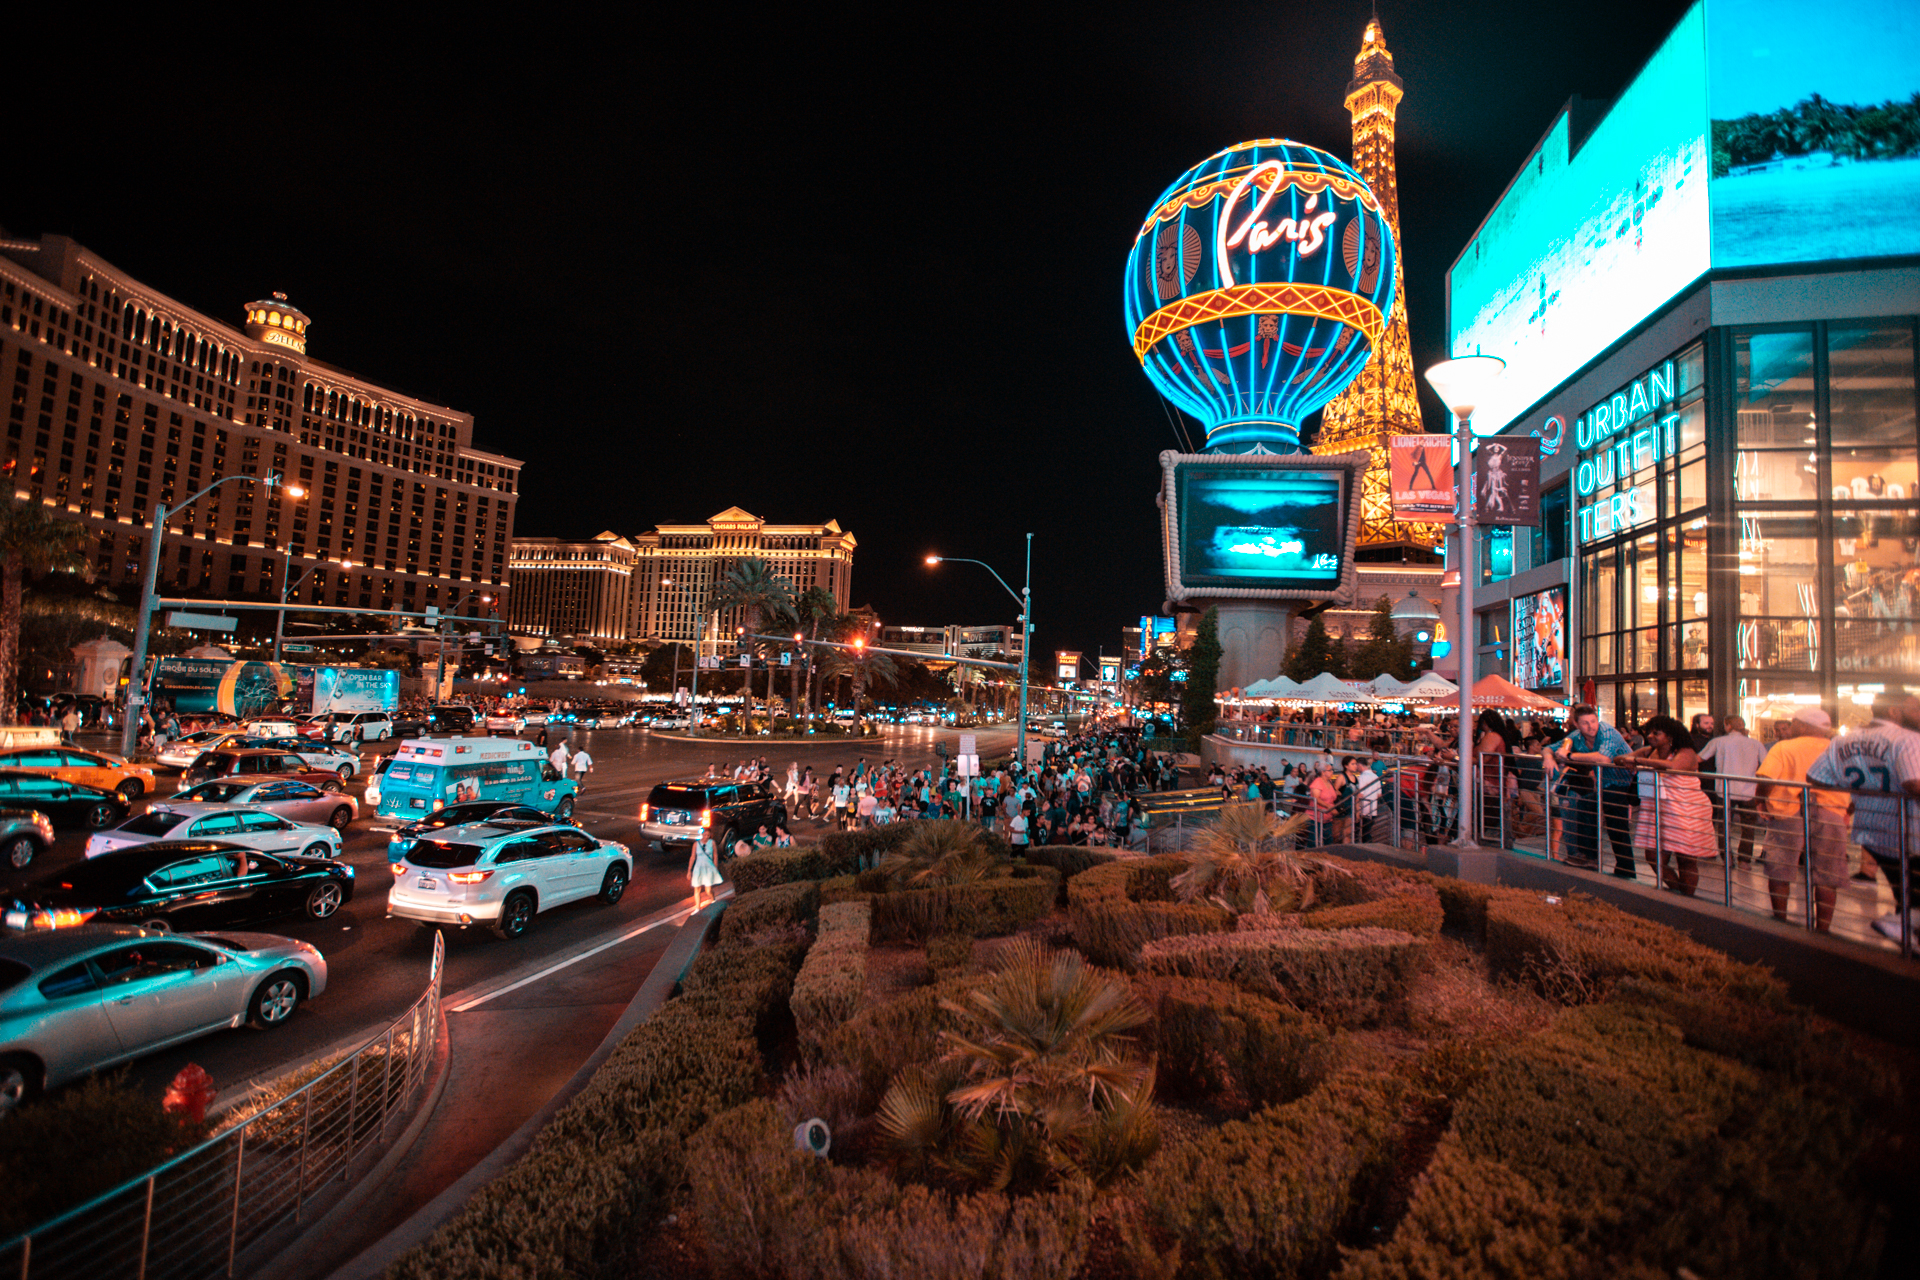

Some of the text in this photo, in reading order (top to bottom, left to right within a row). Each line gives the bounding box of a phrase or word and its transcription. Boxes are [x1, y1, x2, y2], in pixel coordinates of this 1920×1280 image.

[1217, 159, 1337, 291] Paris
[1576, 360, 1674, 450] URBAN
[1577, 411, 1680, 496] OUTFIT
[1395, 490, 1451, 501] LAS VEGAS
[1578, 486, 1642, 542] TERS
[967, 633, 983, 642] LOVE
[159, 664, 223, 674] CIRQUE DU SOLEIL
[348, 673, 382, 682] OPEN BAR
[365, 681, 379, 689] THE
[480, 751, 511, 760] MEDICWEST
[1838, 740, 1889, 762] RUSSELL
[1845, 766, 1890, 791] 27
